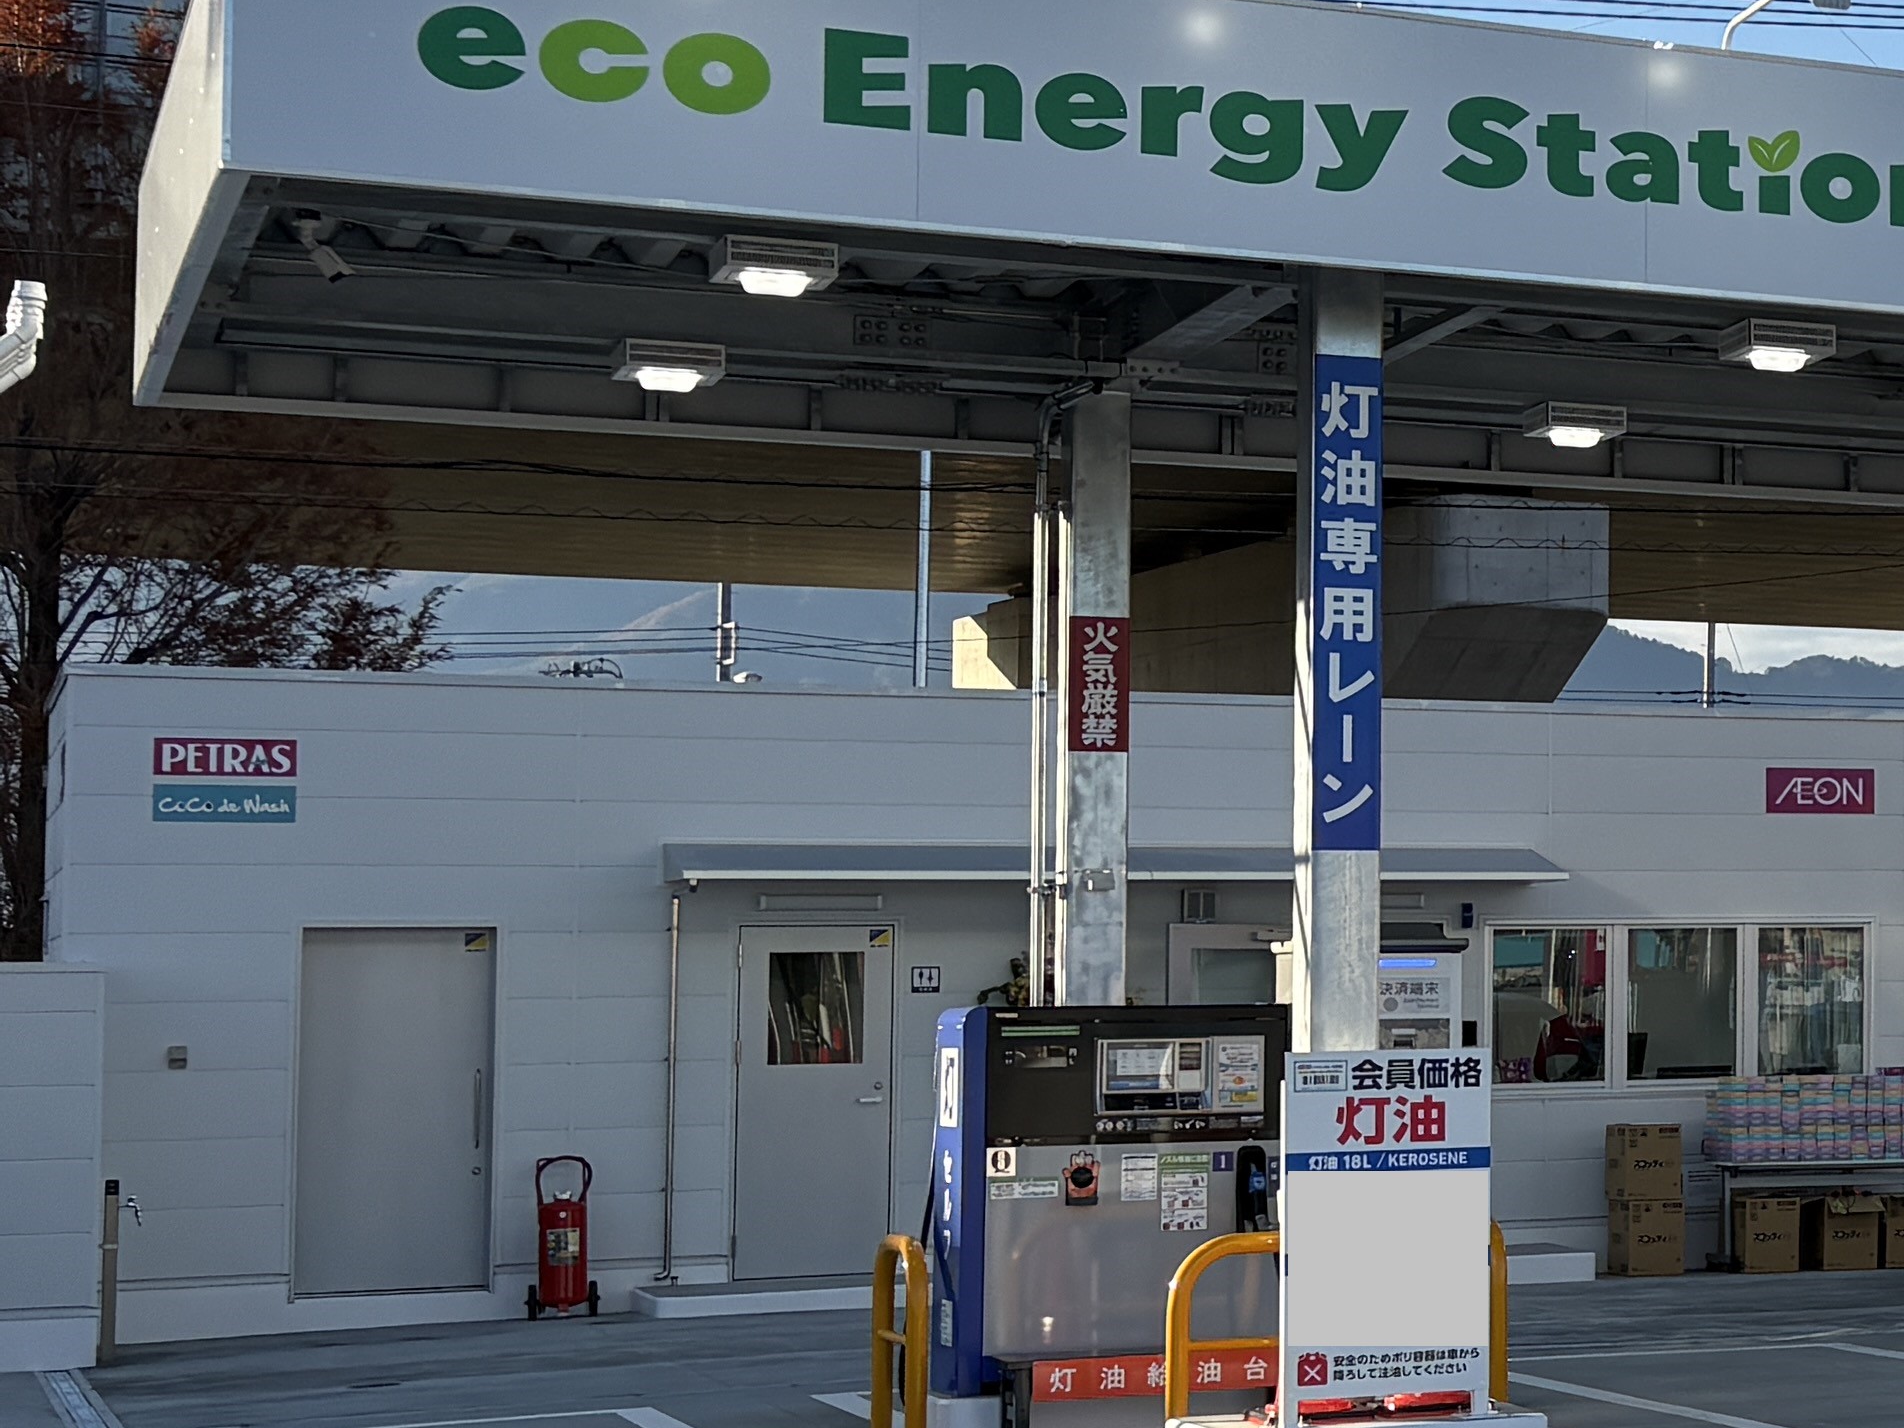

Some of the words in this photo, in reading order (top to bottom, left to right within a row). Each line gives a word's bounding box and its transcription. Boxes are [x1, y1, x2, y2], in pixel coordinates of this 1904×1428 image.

[417, 4, 771, 115] eco
[823, 28, 1409, 192] Energy
[1320, 382, 1379, 824] 灯油専用レーン
[1081, 621, 1119, 748] 火気厳禁
[162, 743, 292, 773] PETRAS
[1351, 1057, 1482, 1091] 会員価格
[1335, 1095, 1446, 1146] 灯油
[1308, 1155, 1338, 1171] 灯油
[1342, 1154, 1372, 1170] 18L
[1388, 1151, 1468, 1167] KEROSENE
